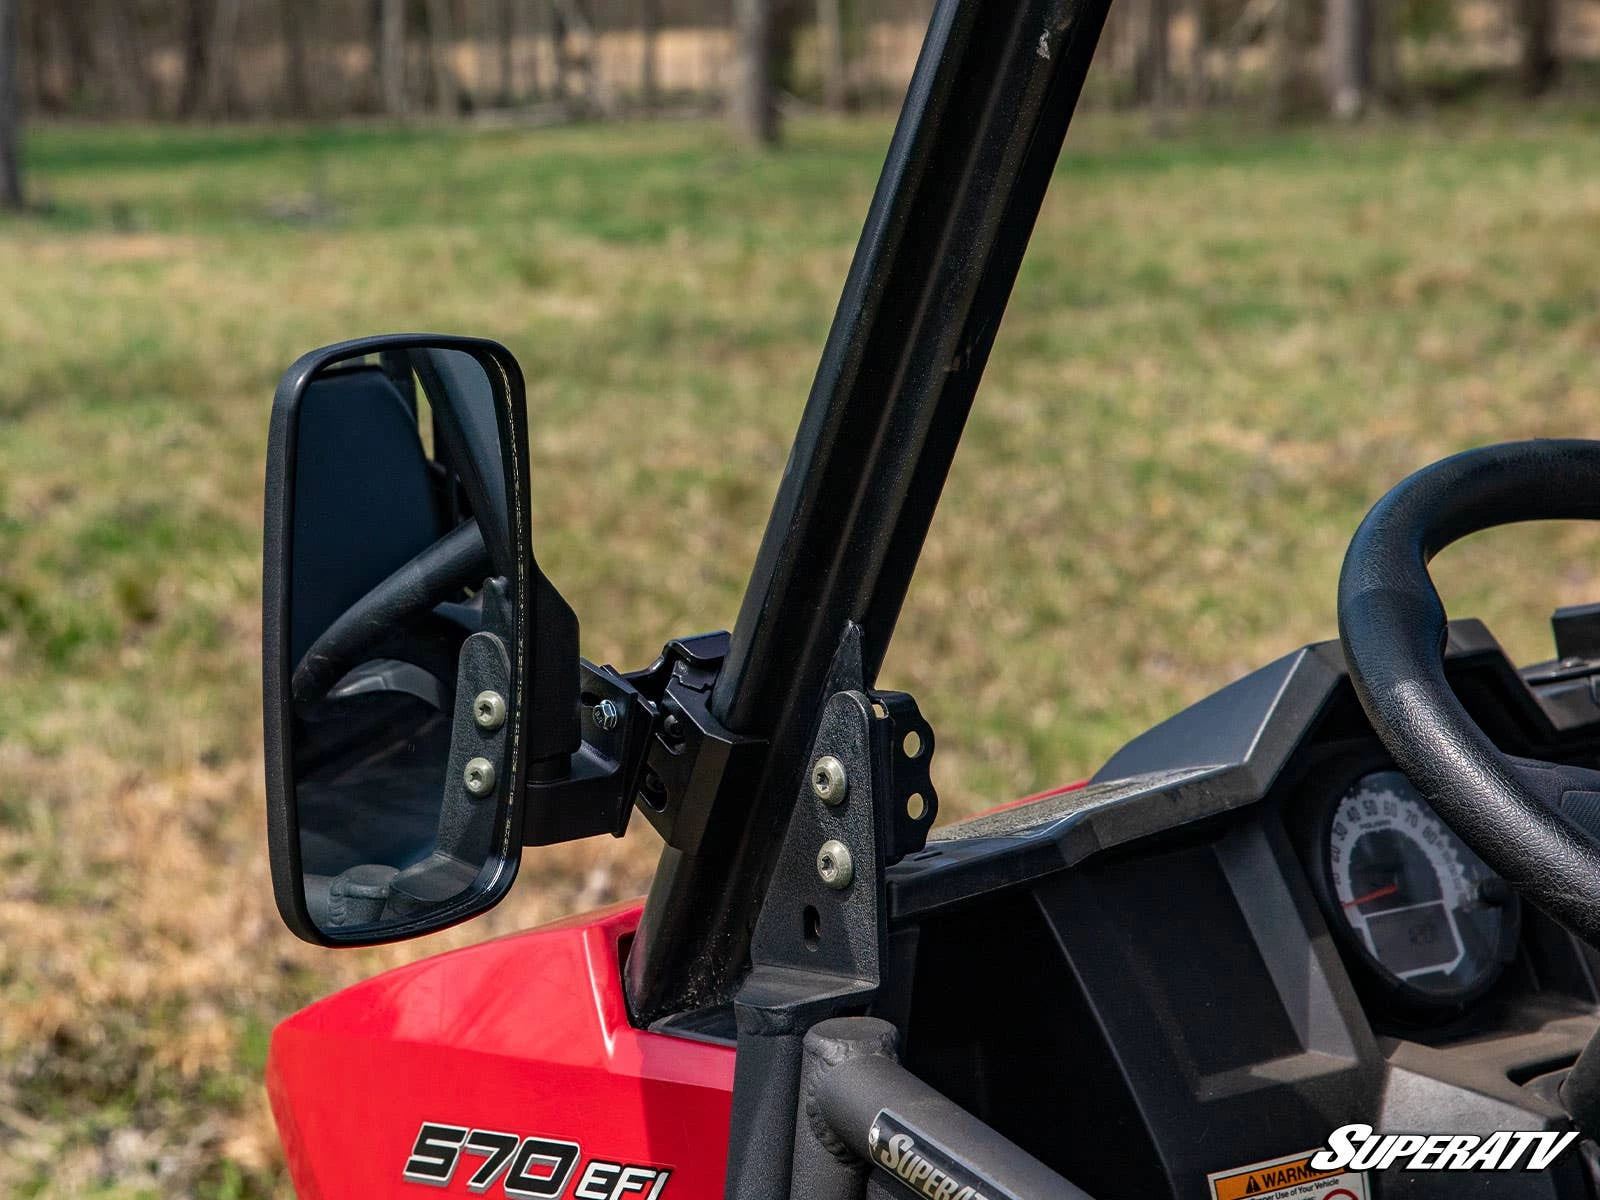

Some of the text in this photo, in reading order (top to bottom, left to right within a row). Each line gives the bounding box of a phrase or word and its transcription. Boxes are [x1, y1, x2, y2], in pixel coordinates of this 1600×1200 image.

[1405, 808, 1419, 829] 70
[403, 1121, 672, 1200] 570 EFI
[1261, 1164, 1323, 1188] WARN
[1275, 1191, 1289, 1200] Use
[1290, 1188, 1298, 1196] of
[1298, 1184, 1314, 1194] Your
[1314, 1178, 1340, 1190] Vehicle
